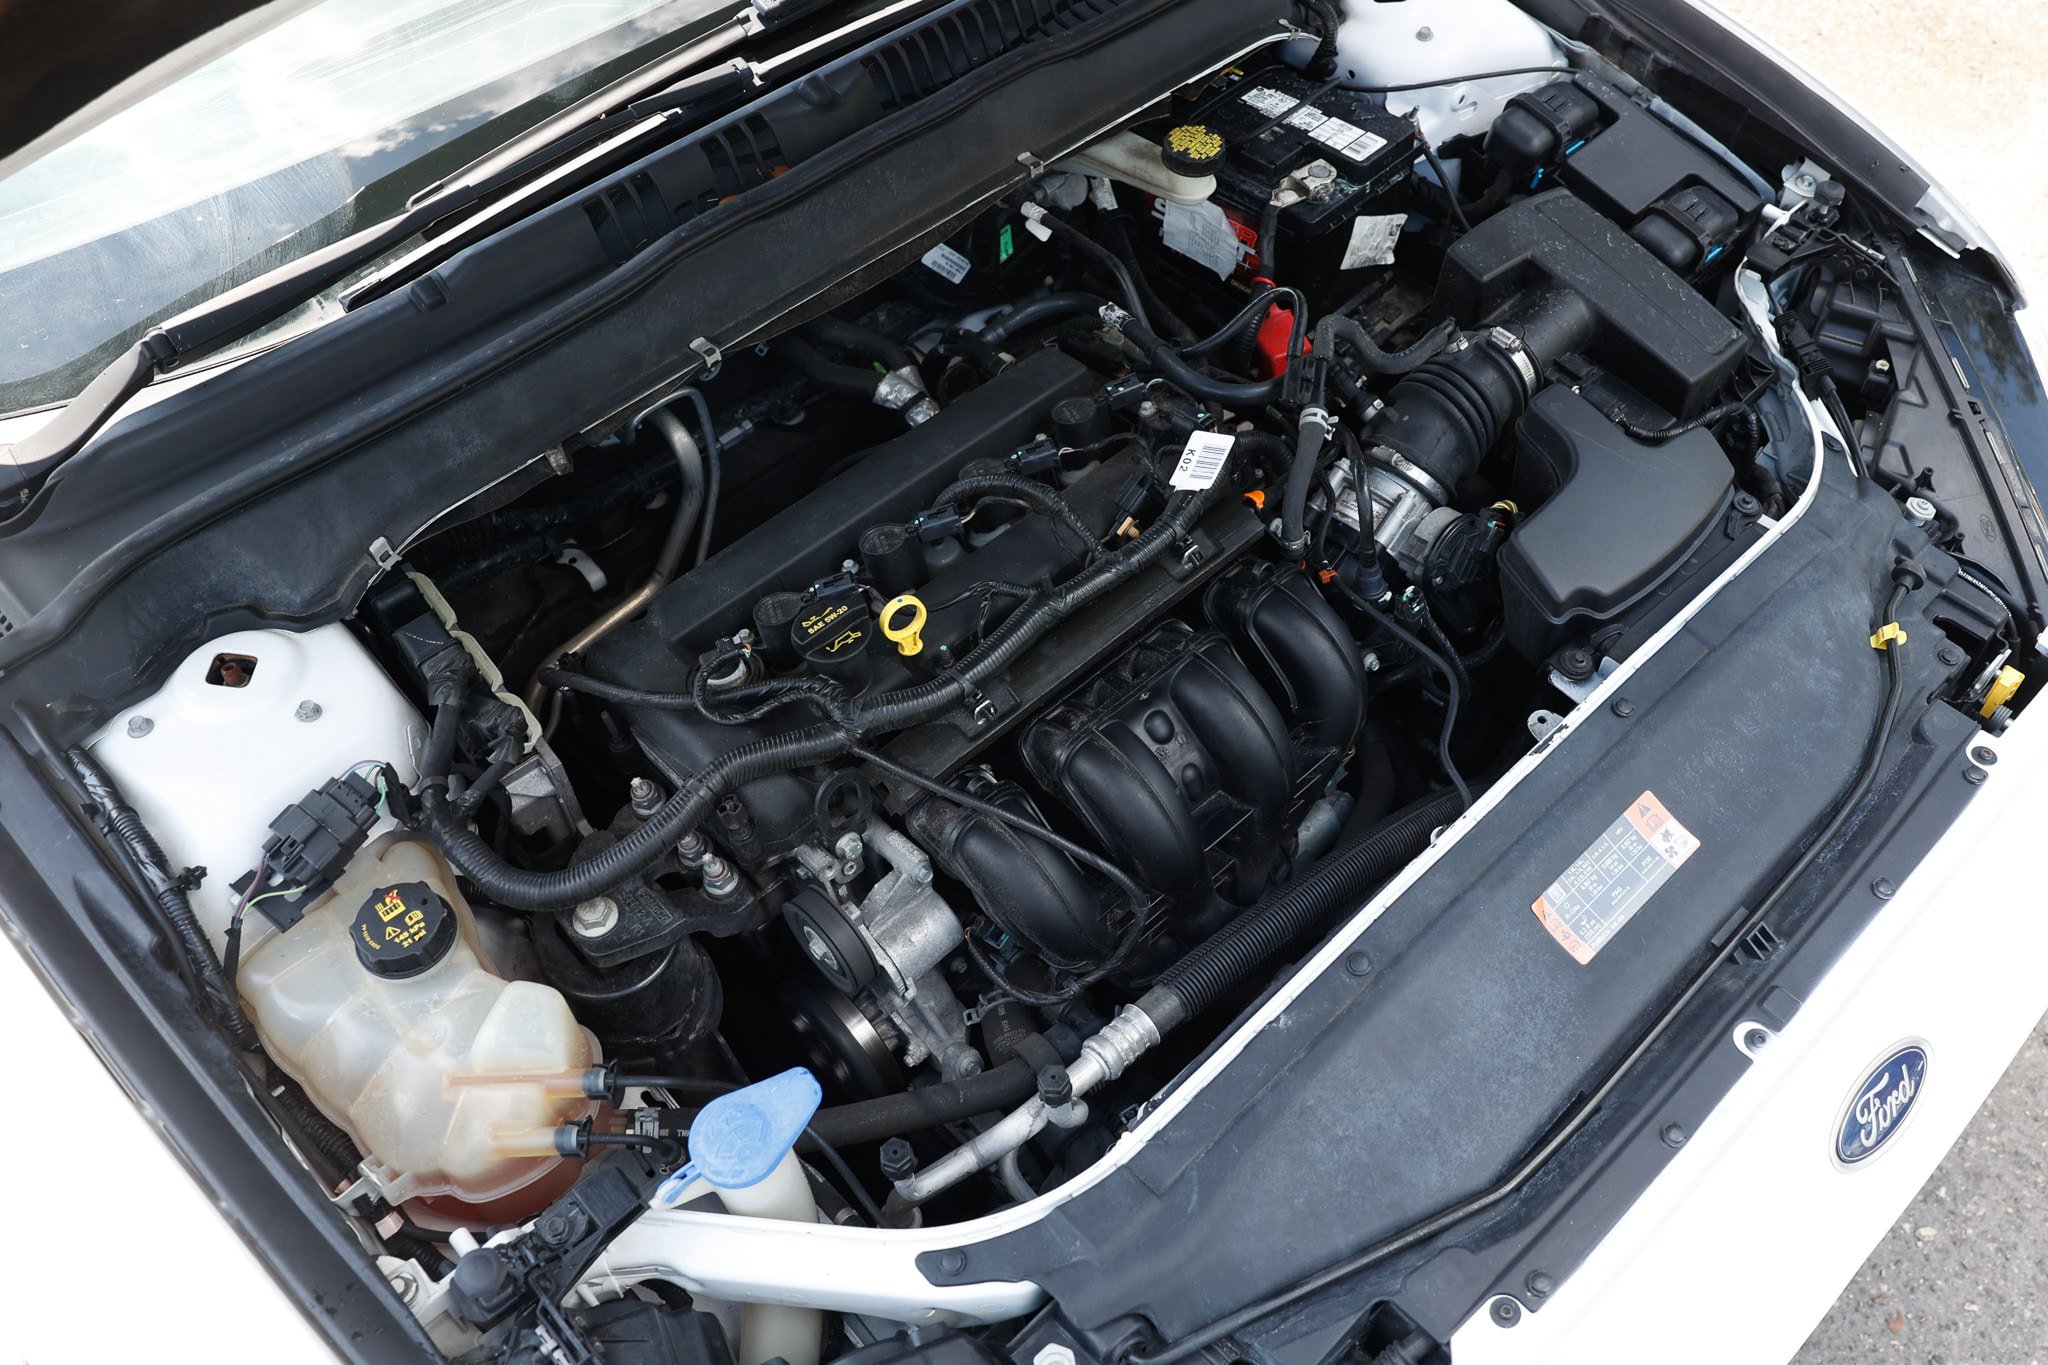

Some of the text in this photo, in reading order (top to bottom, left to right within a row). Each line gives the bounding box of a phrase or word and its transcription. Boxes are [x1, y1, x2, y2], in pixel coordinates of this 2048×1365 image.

[808, 605, 848, 634] SAE 5W-20
[402, 929, 427, 948] 21 psi
[409, 922, 425, 933] kPa
[1855, 1063, 1915, 1148] Ford
